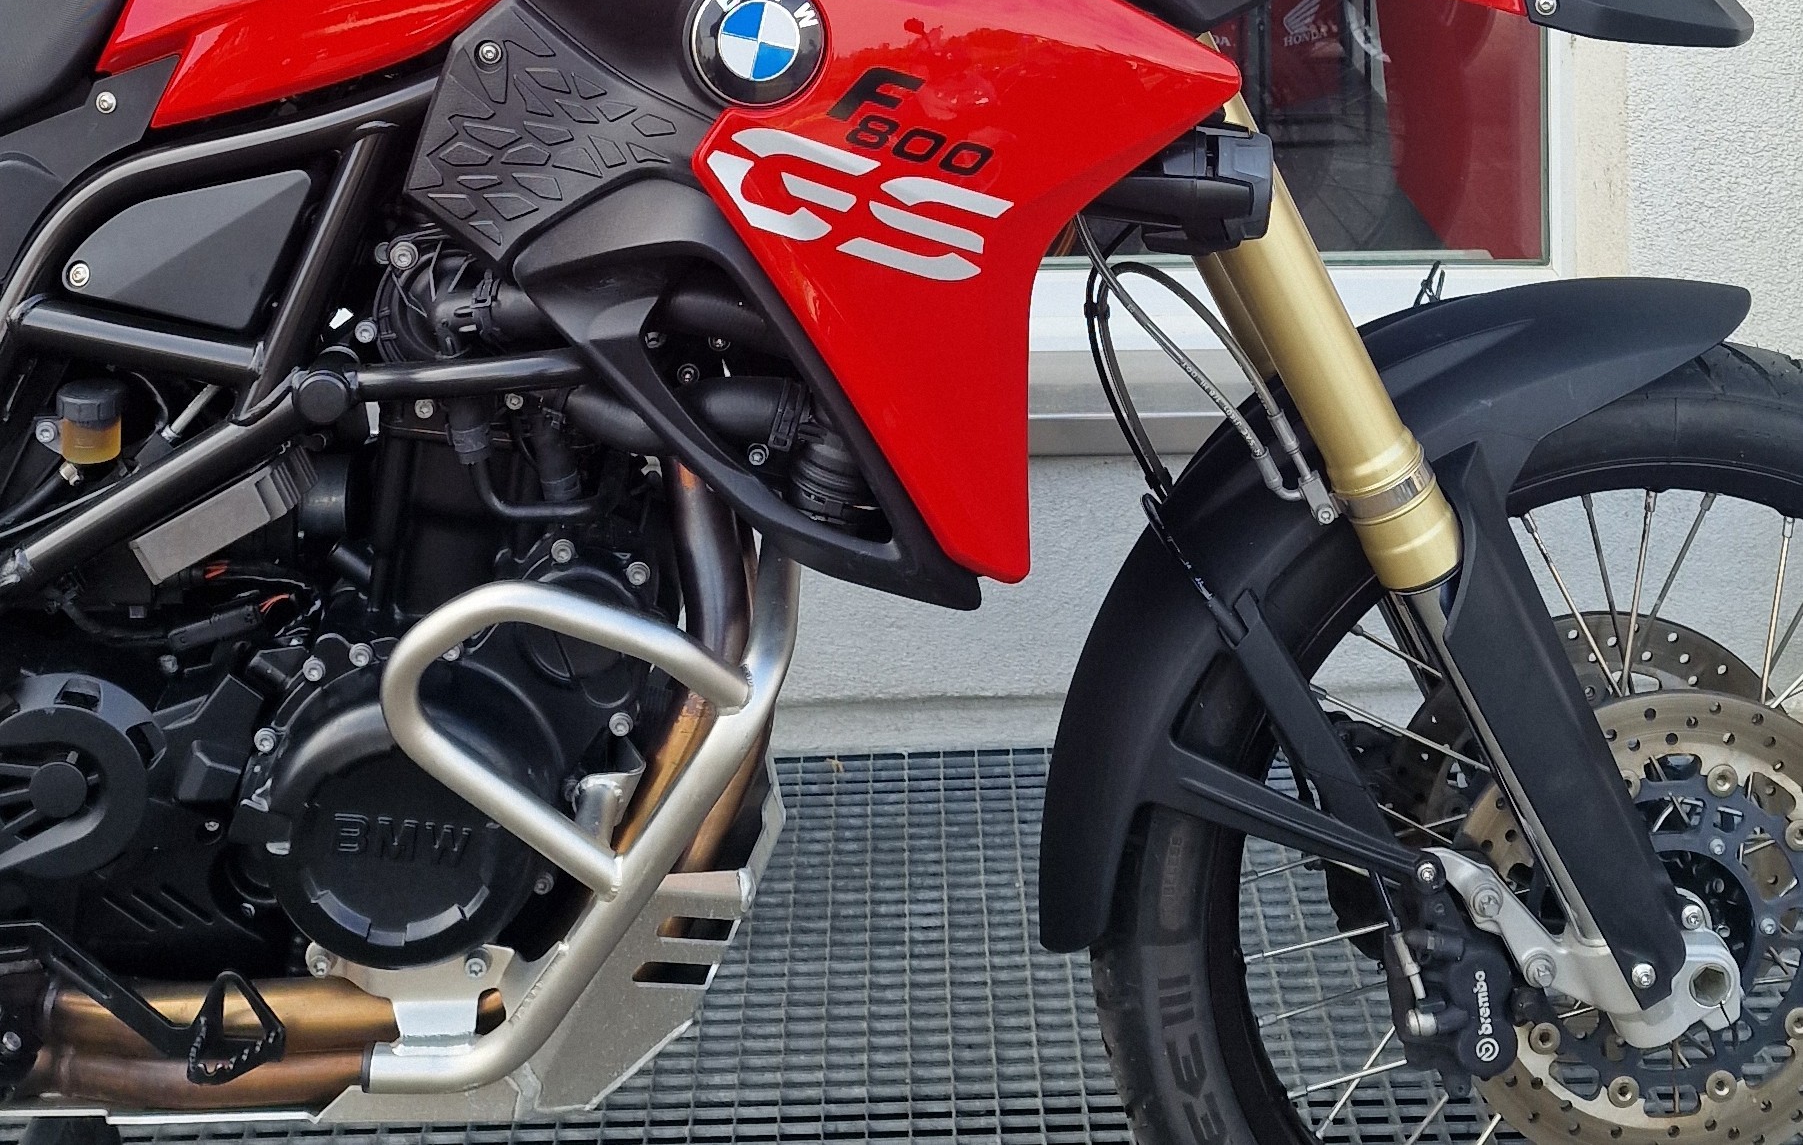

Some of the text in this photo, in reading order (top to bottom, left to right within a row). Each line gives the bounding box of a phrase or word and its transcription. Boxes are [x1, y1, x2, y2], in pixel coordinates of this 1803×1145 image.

[1283, 30, 1329, 47] HONDA
[826, 67, 927, 122] F
[845, 115, 995, 177] 800
[706, 127, 1015, 282] GS
[332, 812, 473, 866] BMW
[1472, 970, 1494, 1036] brembo
